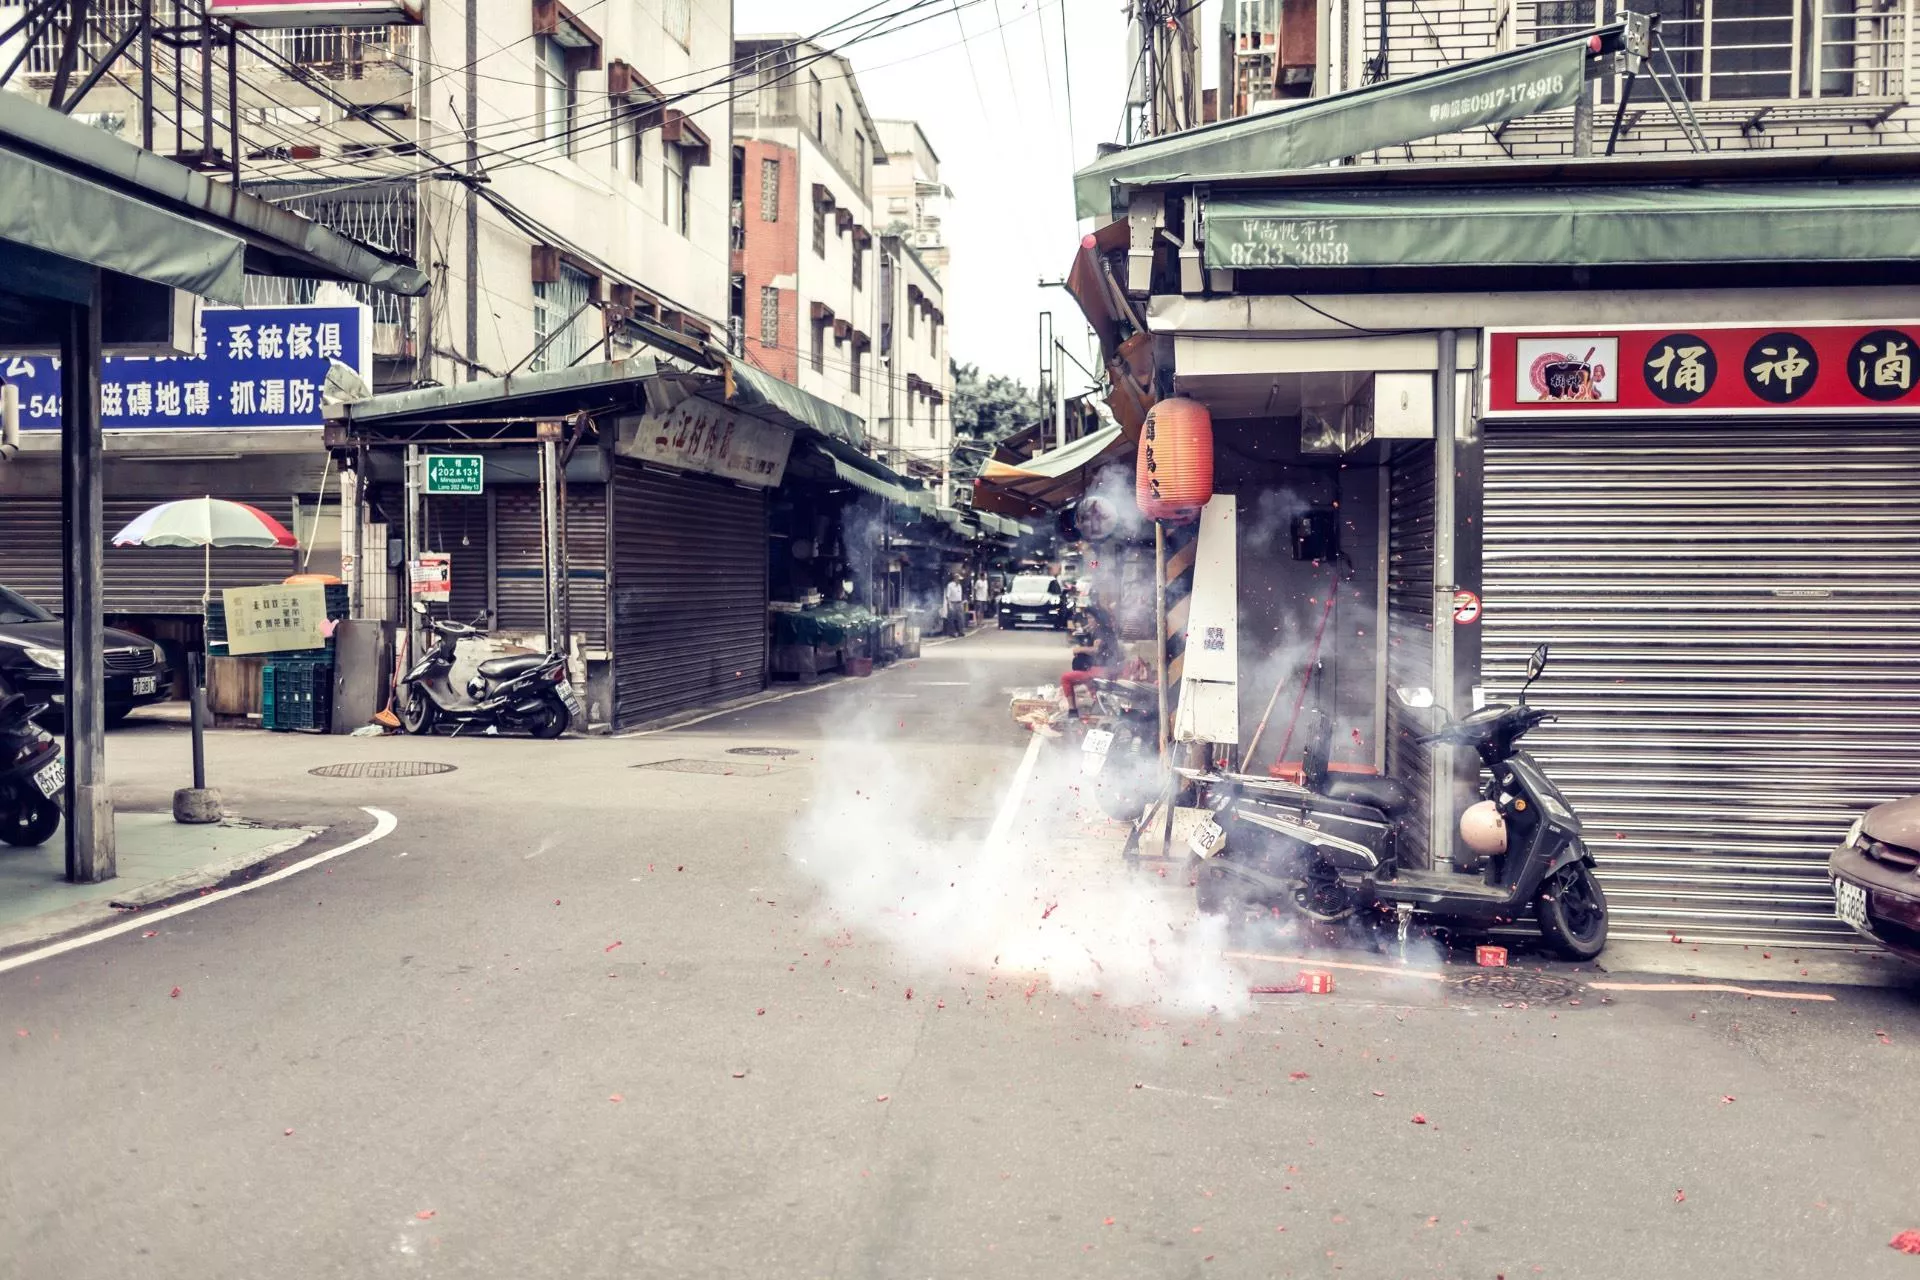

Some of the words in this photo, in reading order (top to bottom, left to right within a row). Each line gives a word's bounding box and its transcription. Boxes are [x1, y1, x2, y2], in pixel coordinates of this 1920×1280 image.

[1231, 242, 1349, 265] 8733-3858
[438, 459, 478, 467] 民權路
